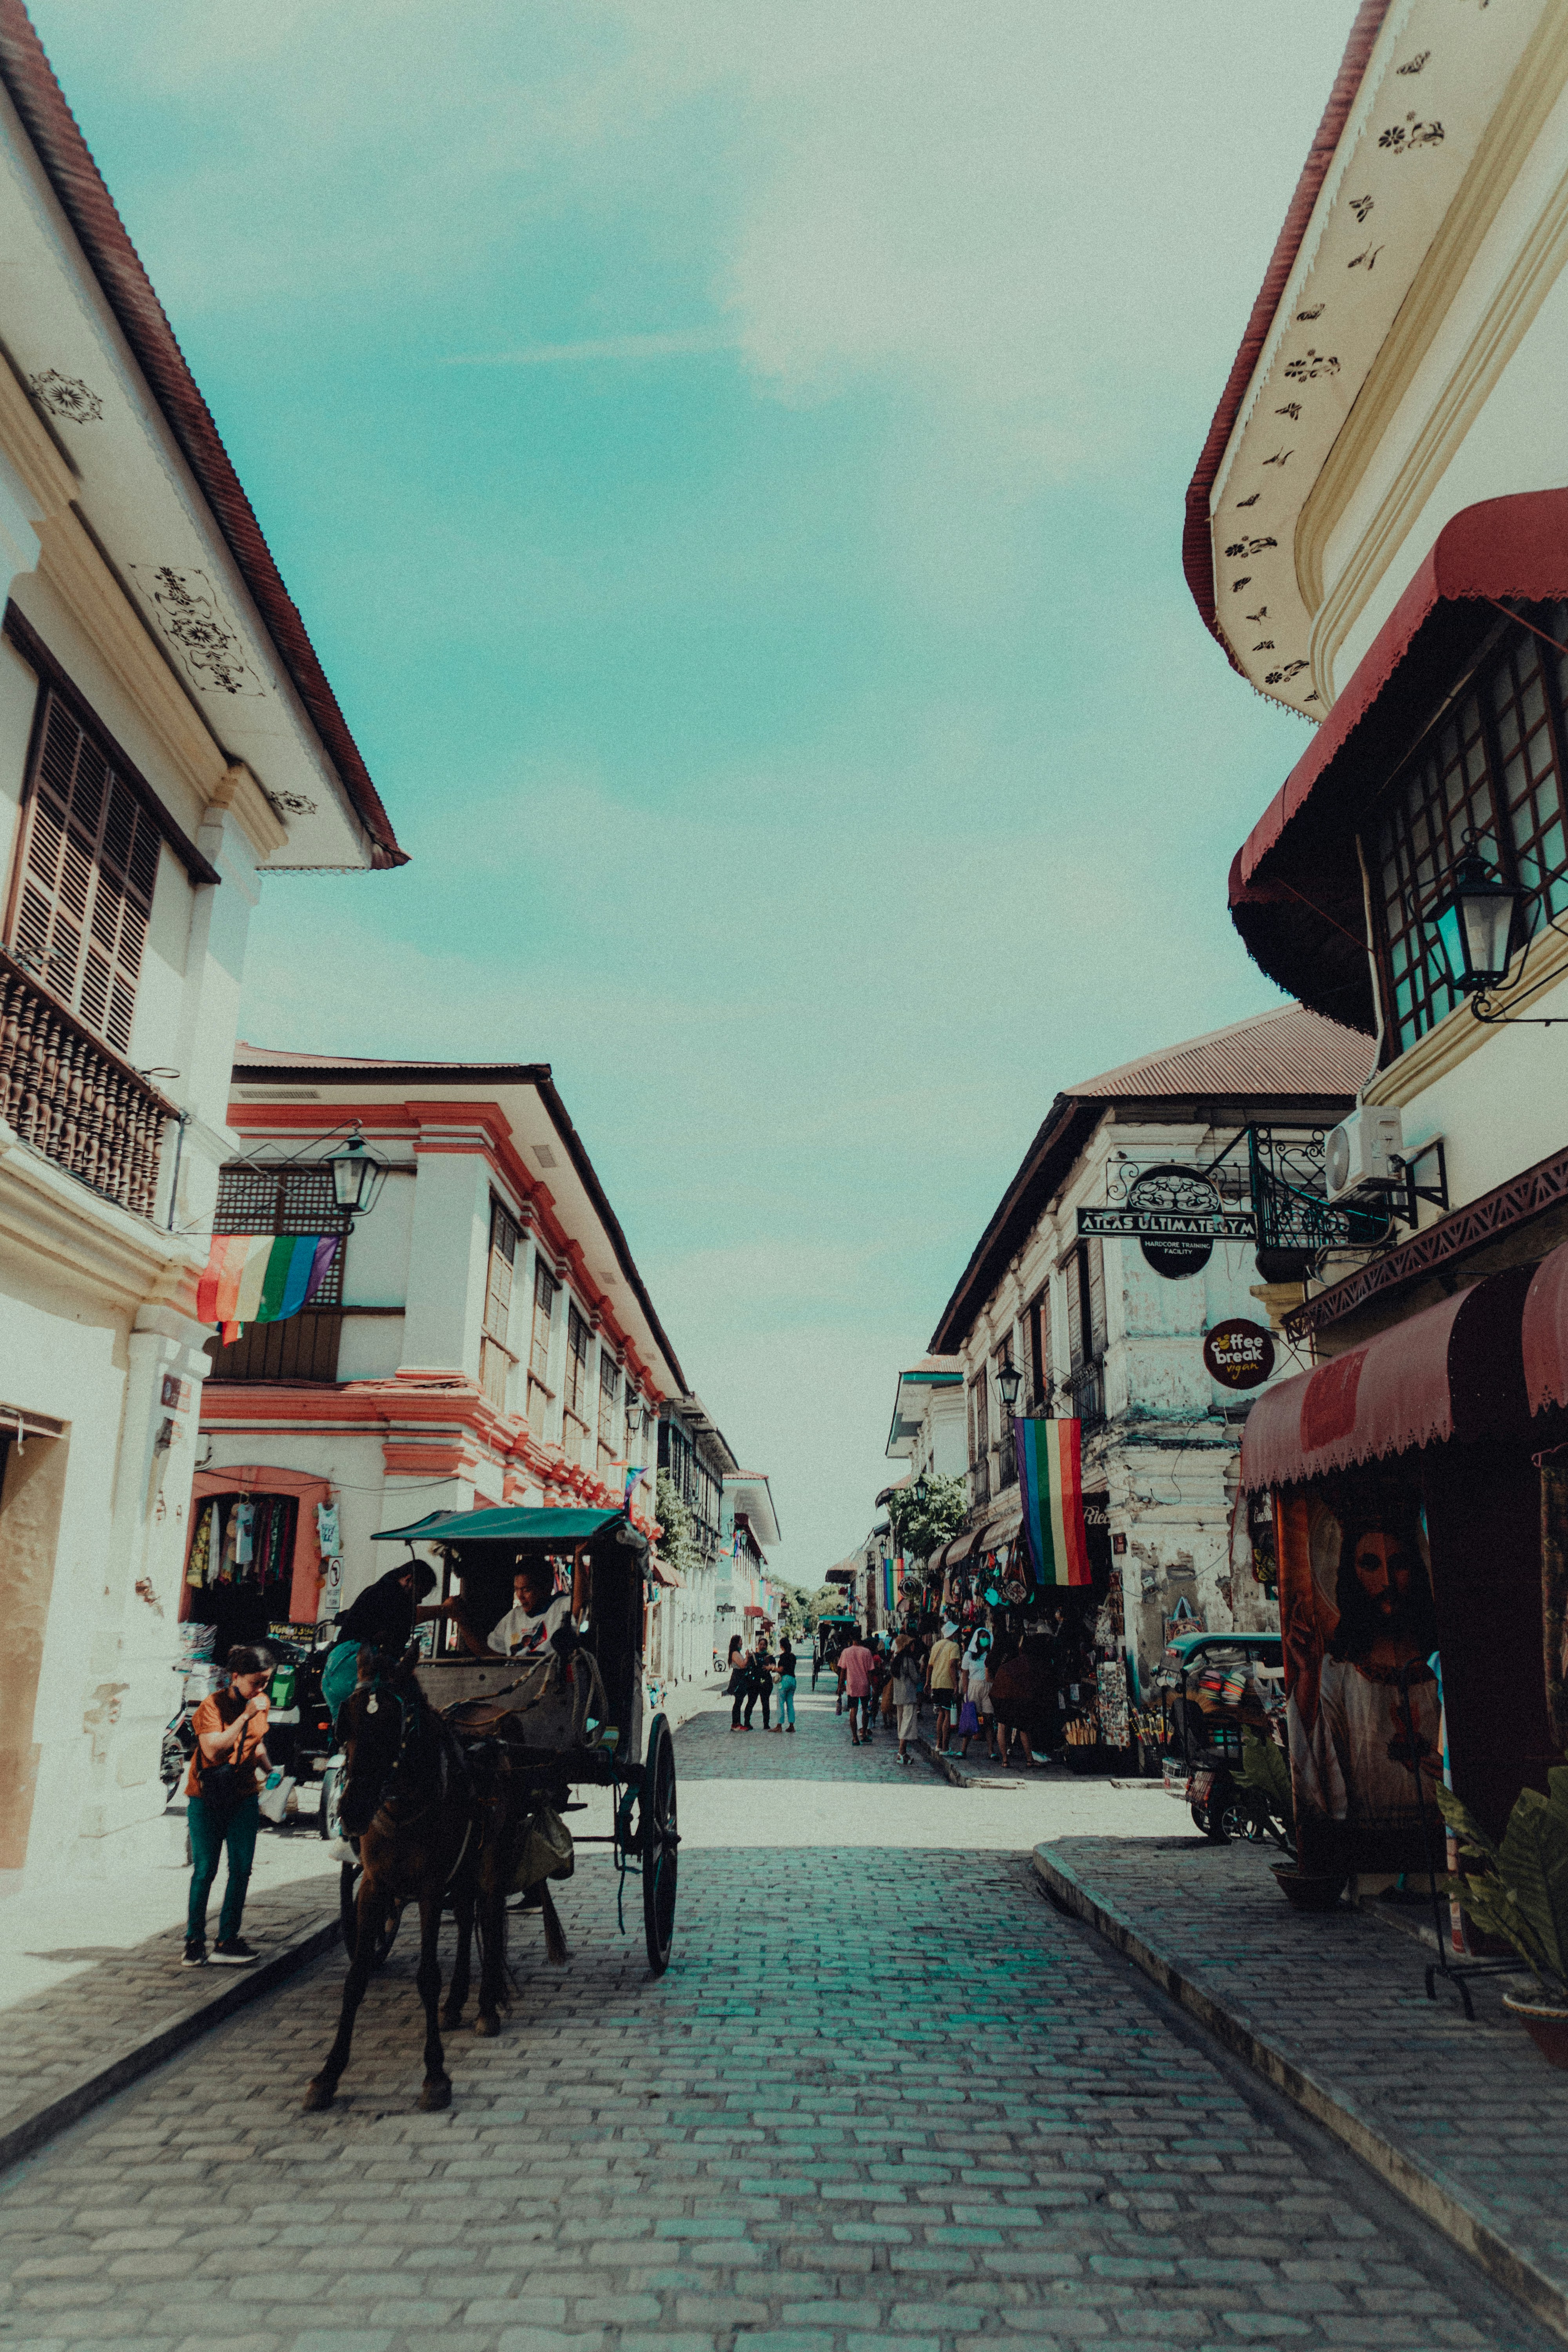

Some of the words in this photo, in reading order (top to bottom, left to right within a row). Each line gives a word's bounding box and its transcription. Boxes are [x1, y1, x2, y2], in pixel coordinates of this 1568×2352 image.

[1082, 1216, 1134, 1229] ATLAS
[1138, 1217, 1214, 1232] ULTIMATE
[1215, 1346, 1263, 1364] break
[1226, 1360, 1259, 1380] vigan
